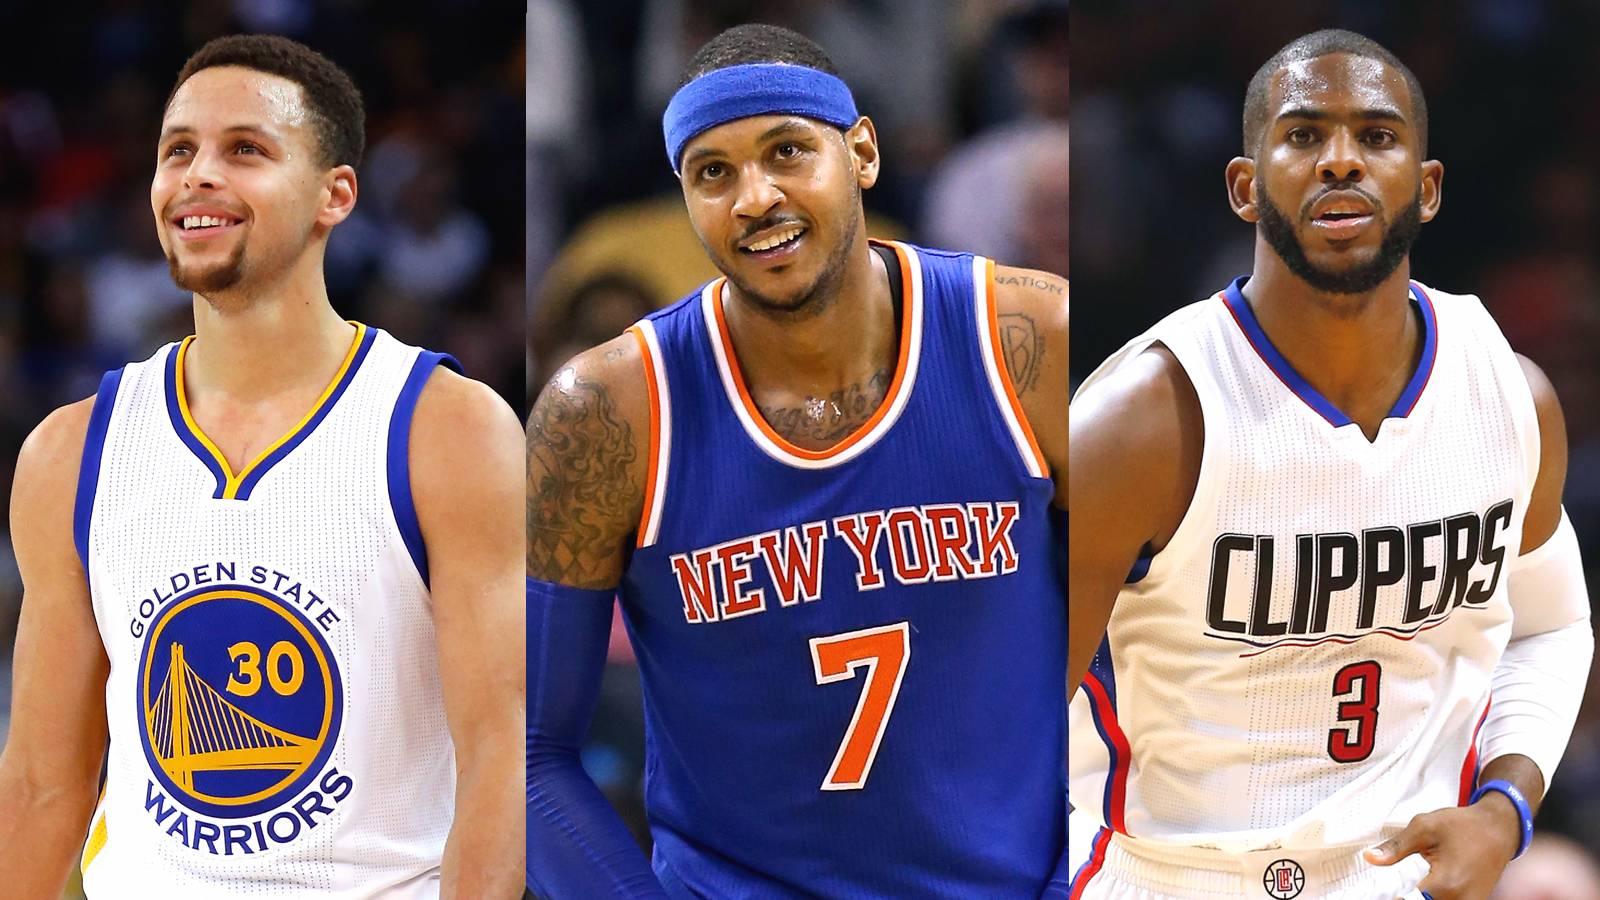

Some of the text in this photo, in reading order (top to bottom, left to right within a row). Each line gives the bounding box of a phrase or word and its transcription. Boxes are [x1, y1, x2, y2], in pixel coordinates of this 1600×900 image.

[130, 562, 341, 639] GOLDEN STATE
[670, 501, 1019, 624] NEW YORK
[1205, 498, 1513, 636] CLIPPERS
[226, 640, 304, 697] 30
[808, 621, 911, 790] 7
[1327, 660, 1382, 763] 3
[144, 766, 354, 856] WARRIORS
